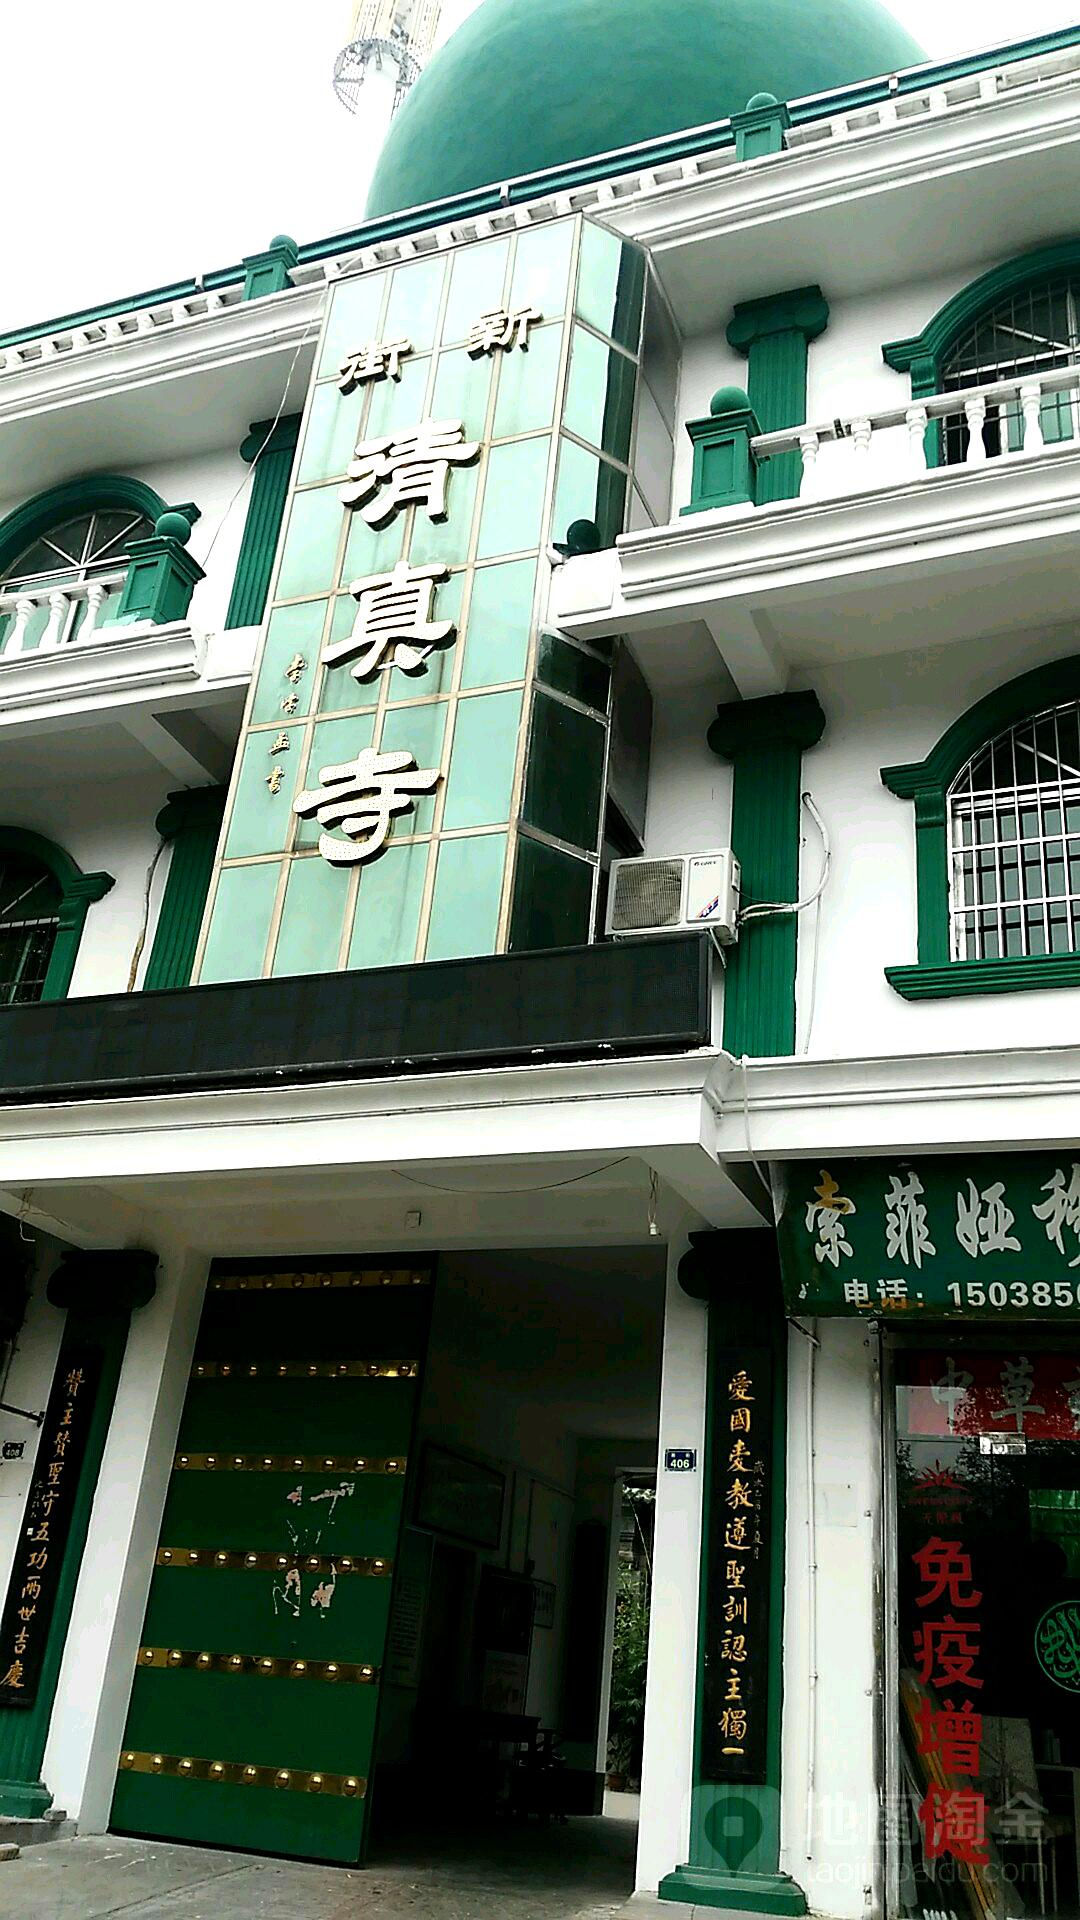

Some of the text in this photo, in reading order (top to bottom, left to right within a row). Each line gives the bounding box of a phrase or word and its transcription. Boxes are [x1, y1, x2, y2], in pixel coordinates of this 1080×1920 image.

[292, 417, 482, 869] 清真寺
[929, 1356, 1080, 1436] 中草
[670, 1458, 690, 1469] 406
